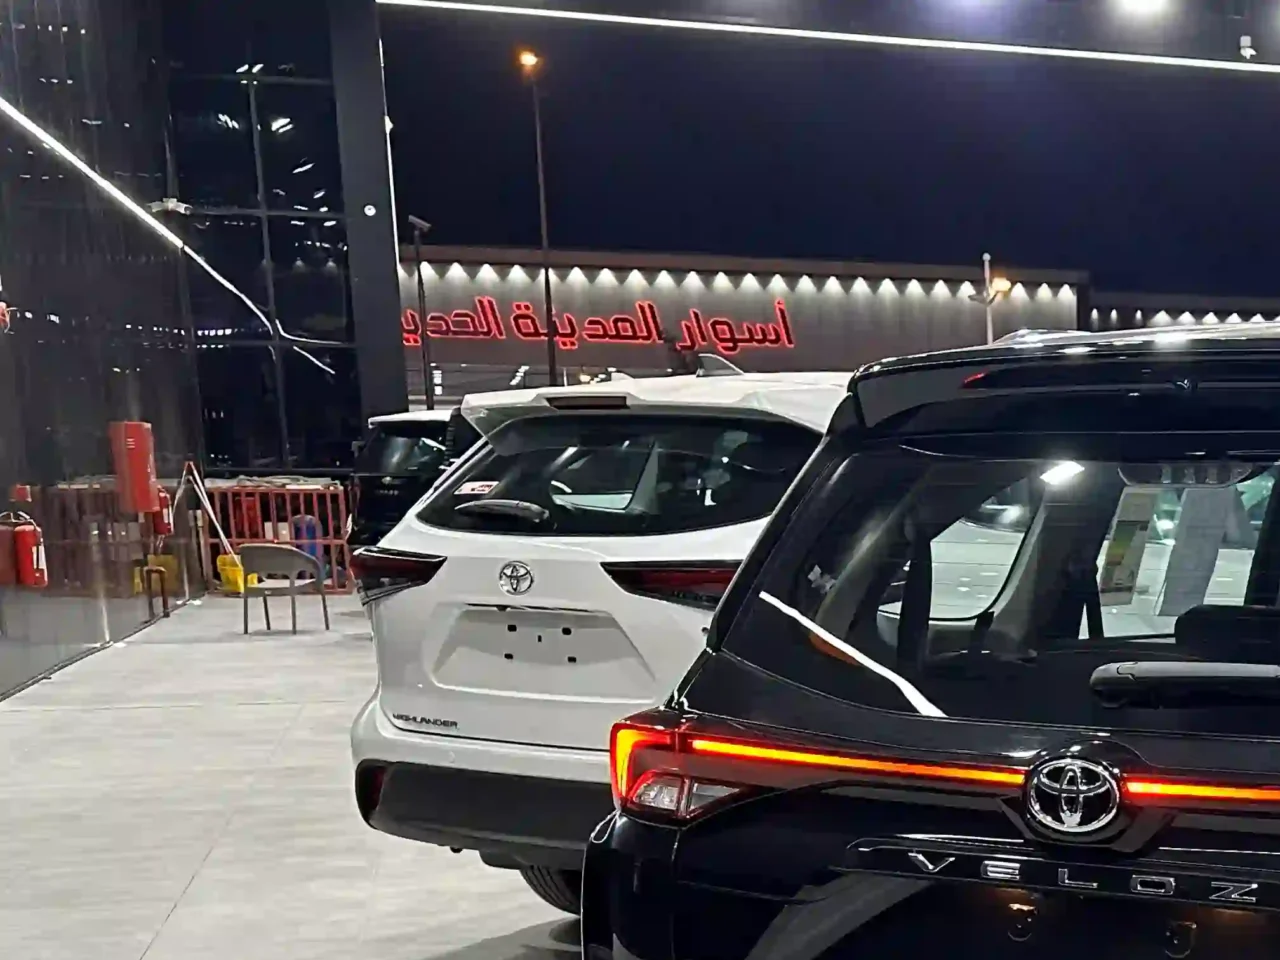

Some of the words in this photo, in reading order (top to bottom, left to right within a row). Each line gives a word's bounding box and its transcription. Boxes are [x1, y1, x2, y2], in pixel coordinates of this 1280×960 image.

[401, 296, 506, 346] الحدي
[676, 297, 794, 354] أسوار
[907, 850, 1258, 902] VELOZ
